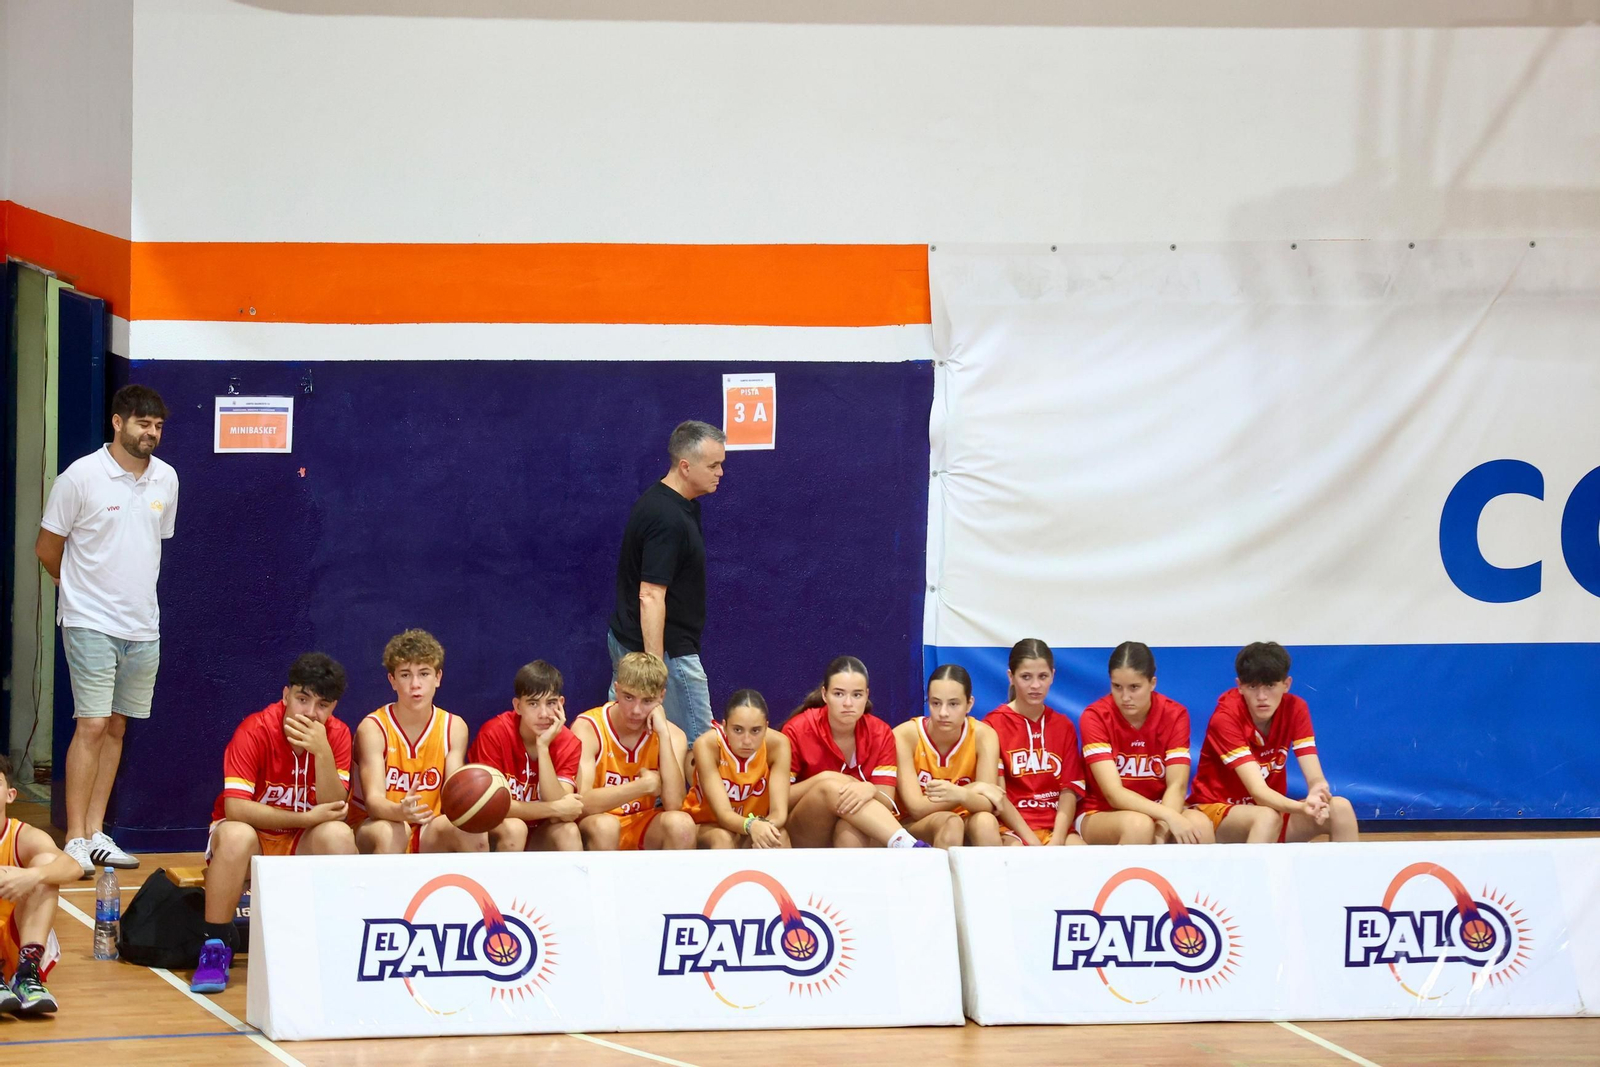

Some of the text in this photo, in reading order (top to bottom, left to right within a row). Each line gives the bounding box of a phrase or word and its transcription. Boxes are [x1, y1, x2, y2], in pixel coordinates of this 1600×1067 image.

[734, 402, 768, 423] 3 A
[740, 388, 760, 396] PISTA
[230, 426, 277, 434] MINIBASKET
[357, 914, 538, 982] EL PALO
[658, 909, 835, 976] EL PALO
[1052, 907, 1222, 973] EL PALO
[1343, 901, 1512, 967] EL PALO
